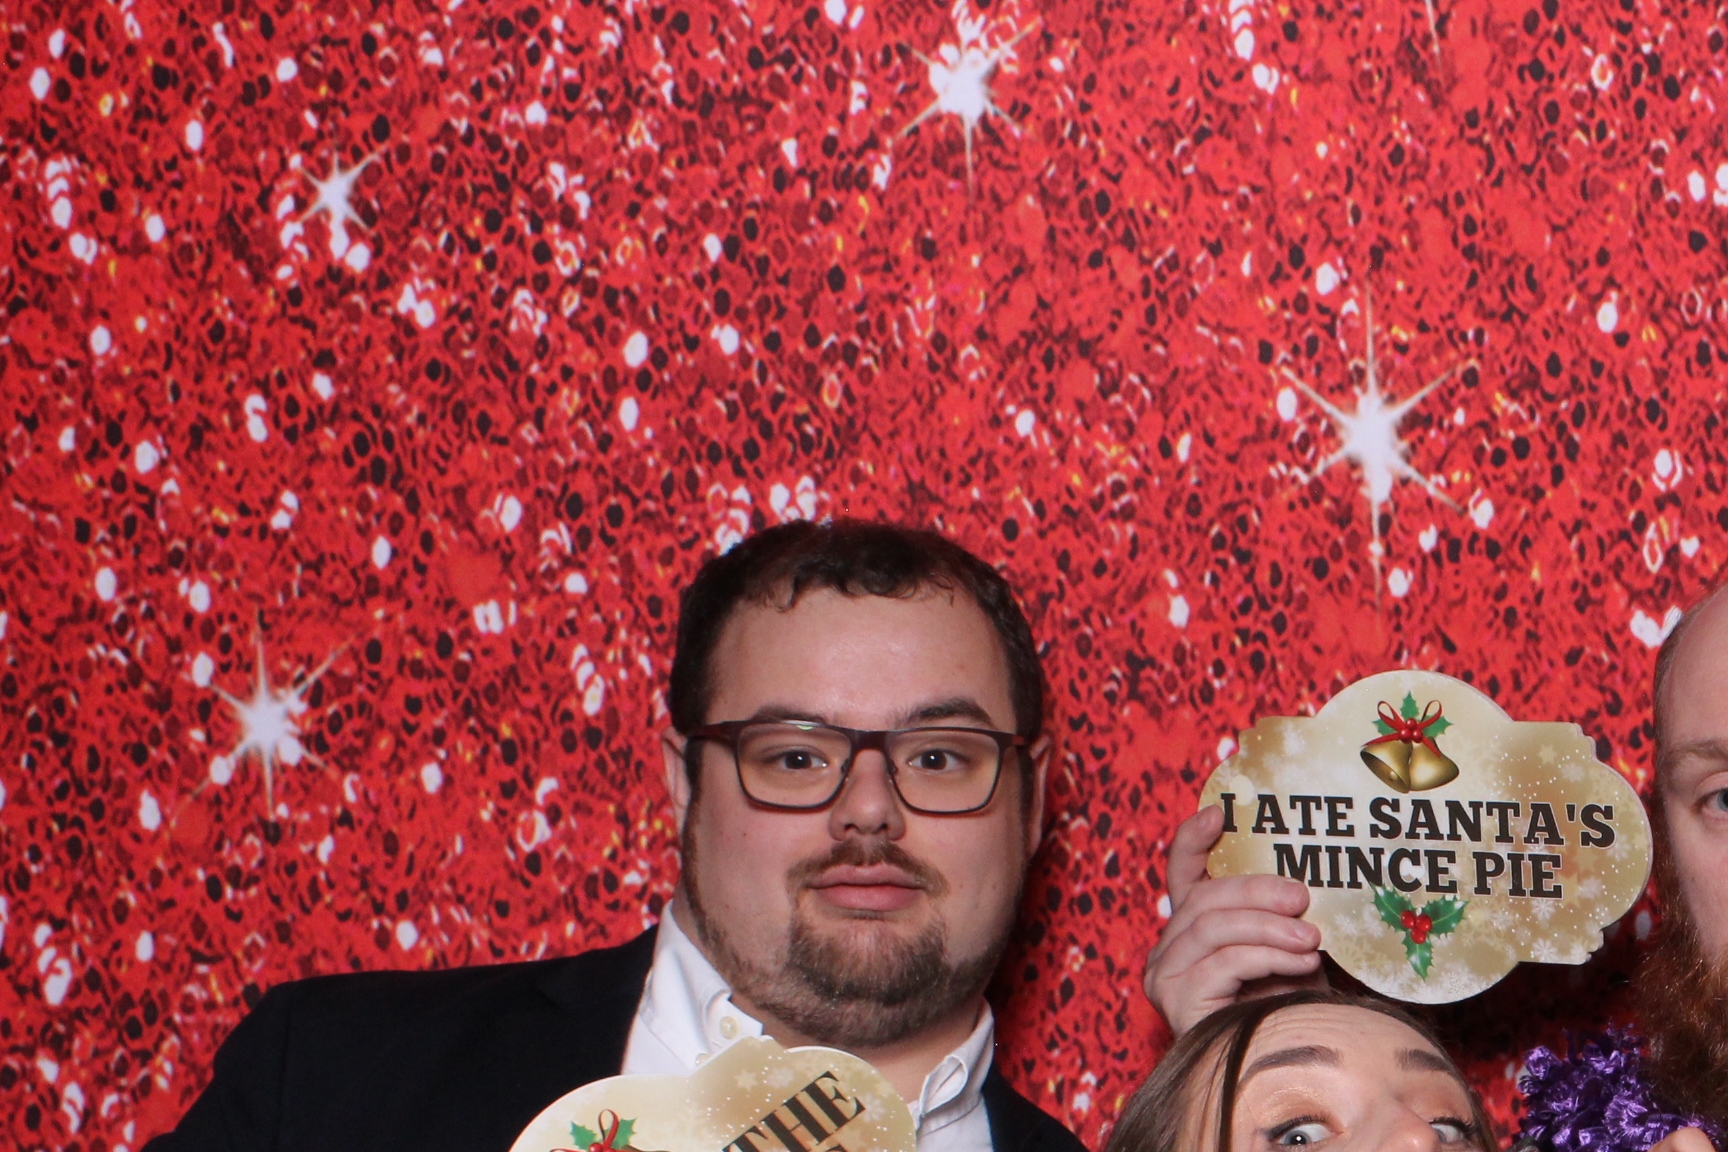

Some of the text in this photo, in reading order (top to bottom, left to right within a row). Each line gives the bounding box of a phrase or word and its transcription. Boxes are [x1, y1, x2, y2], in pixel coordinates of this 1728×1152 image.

[1219, 792, 1616, 848] I ATE SANTA'S
[1273, 843, 1563, 899] MINCE PIE
